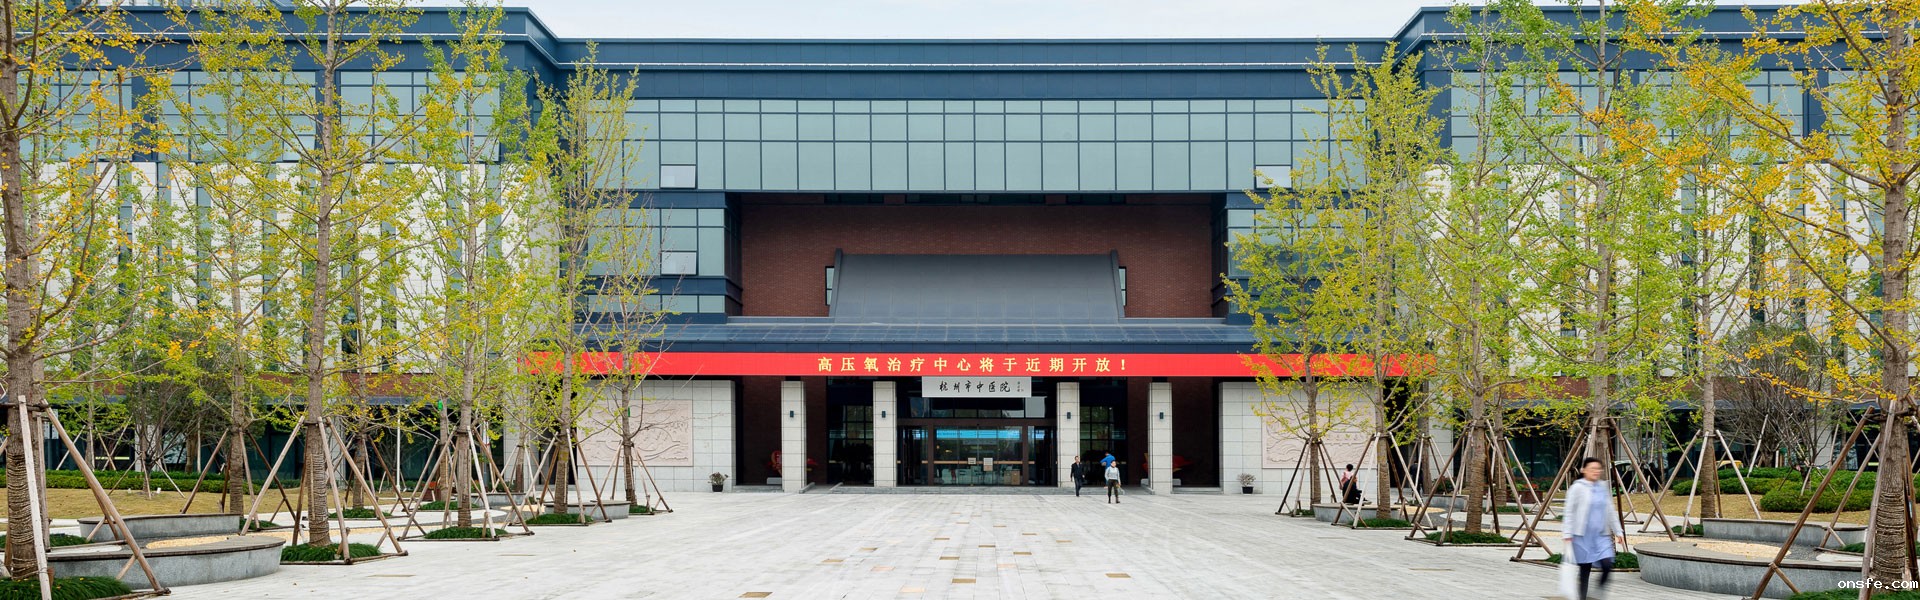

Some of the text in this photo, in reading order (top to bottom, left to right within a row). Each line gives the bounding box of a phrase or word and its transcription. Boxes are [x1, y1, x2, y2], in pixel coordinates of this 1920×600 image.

[817, 356, 1126, 372] 高压氧治疗中心将于近期开放！
[939, 380, 1011, 393] 杭州市中医院
